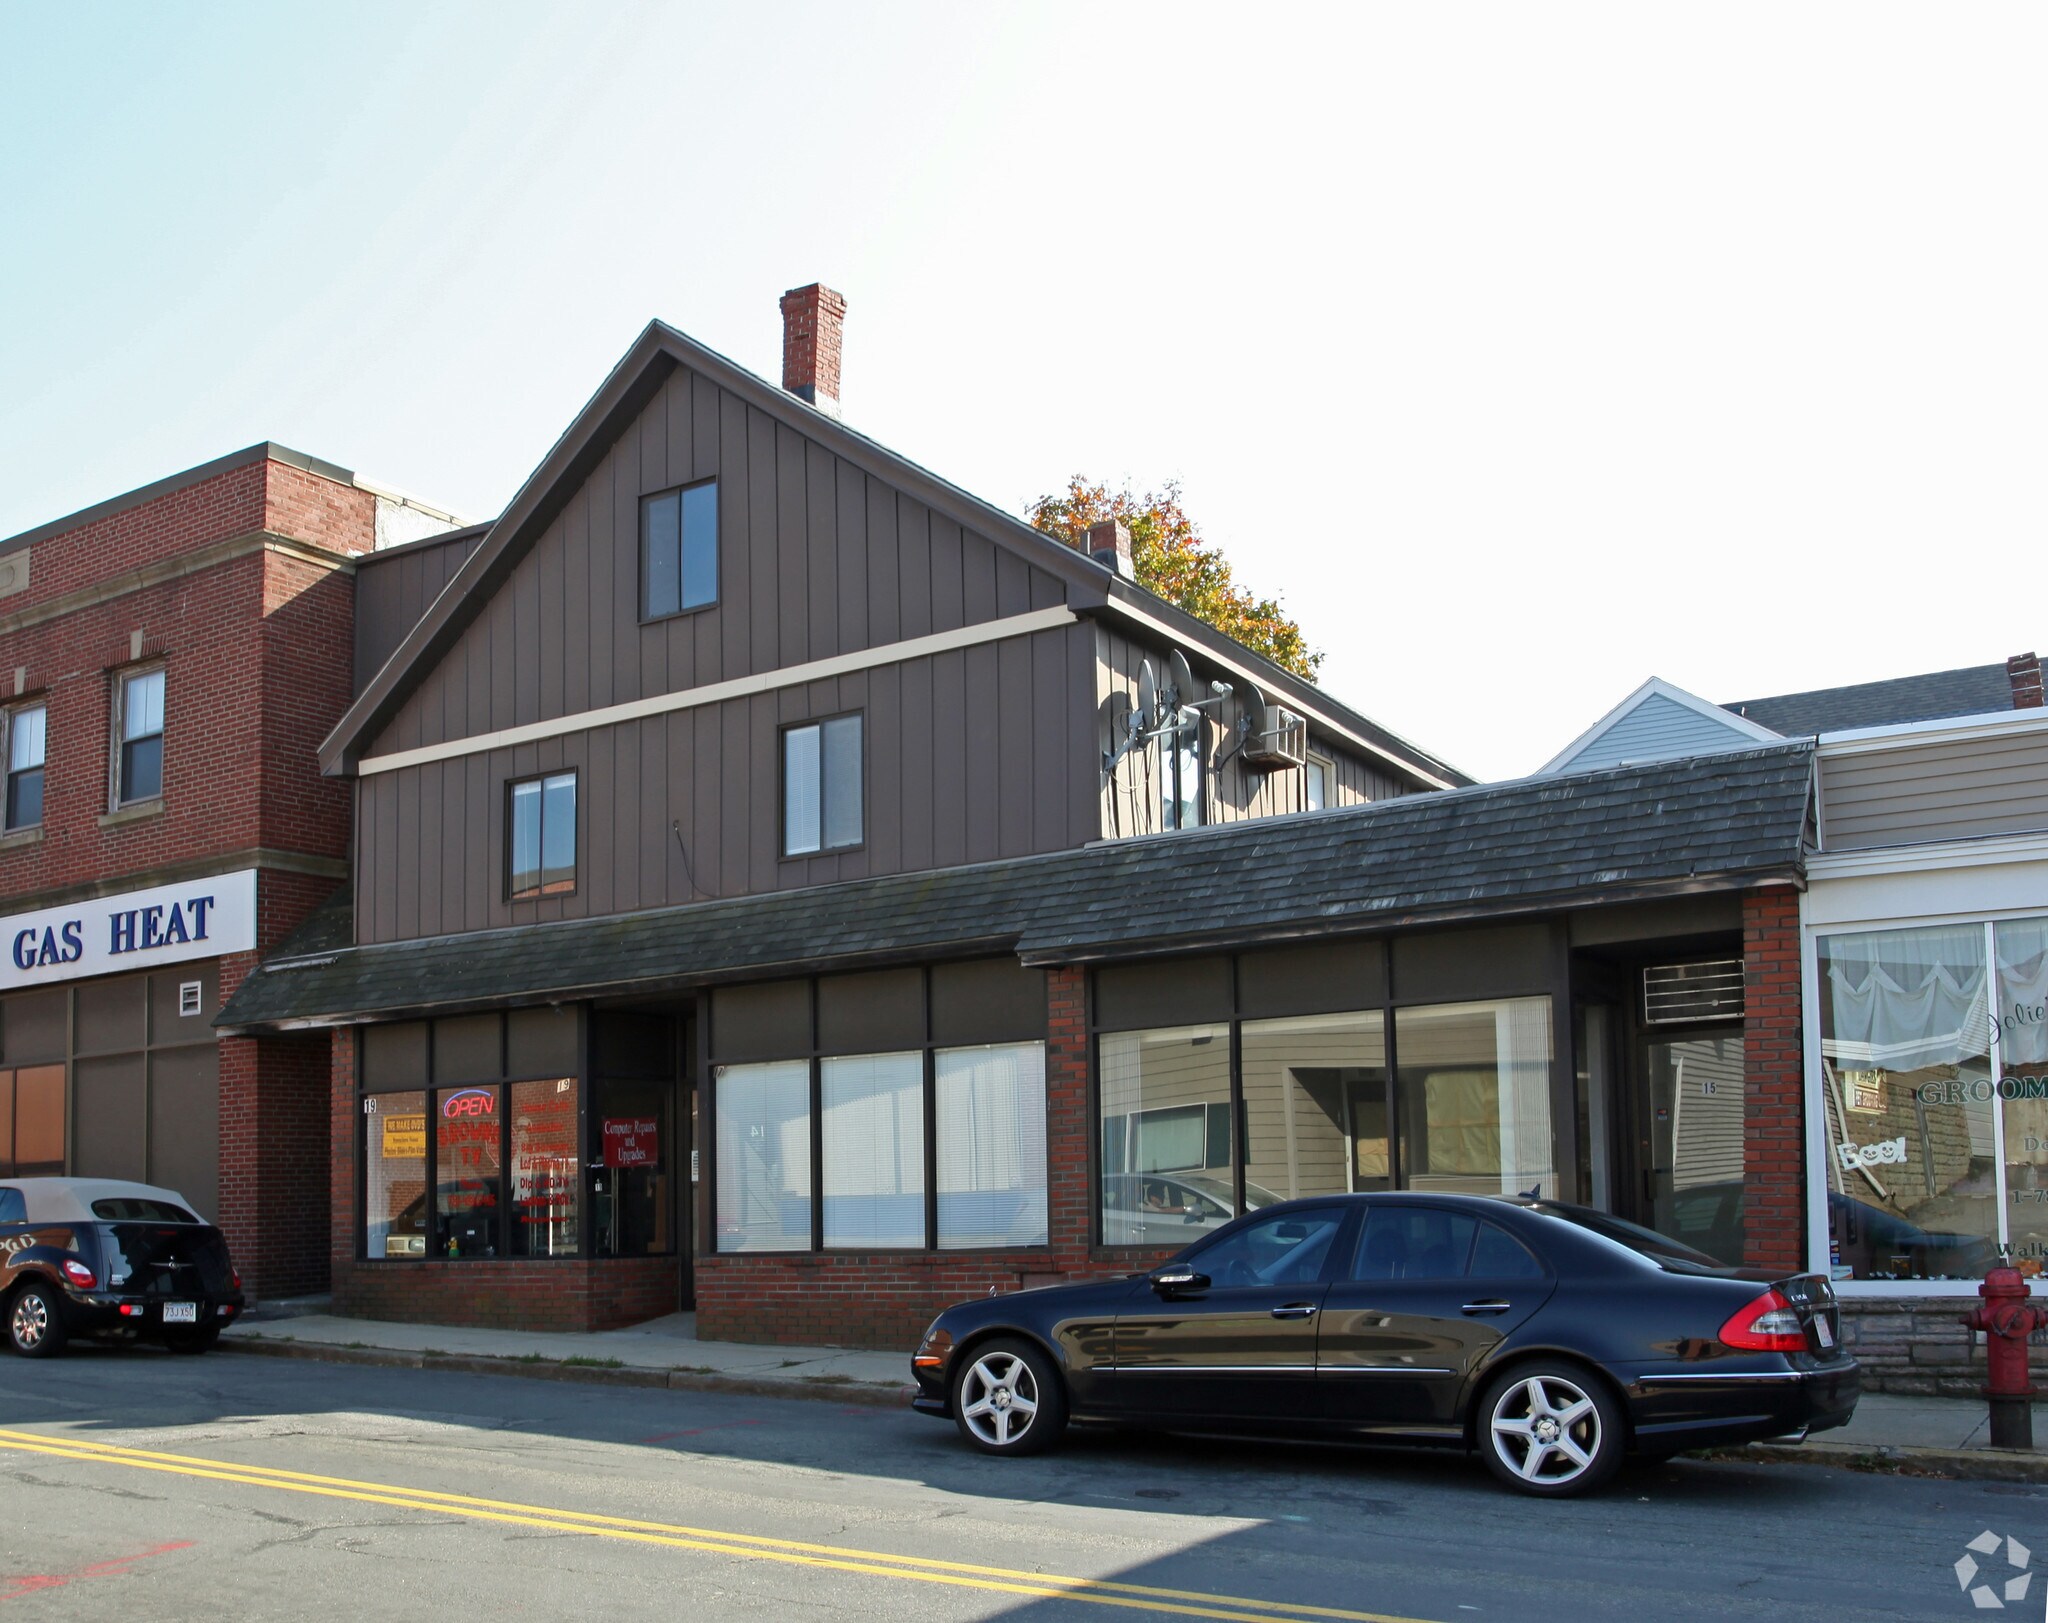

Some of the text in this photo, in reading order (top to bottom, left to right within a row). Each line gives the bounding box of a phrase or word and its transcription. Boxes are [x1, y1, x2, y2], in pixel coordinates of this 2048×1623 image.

[12, 895, 214, 970] GAS HEAT
[559, 1079, 570, 1092] 19
[1703, 1082, 1716, 1095] 15
[365, 1099, 376, 1113] 19
[446, 1096, 494, 1118] OPEN
[604, 1120, 656, 1136] Computer Repairs
[624, 1135, 635, 1147] and
[459, 1147, 481, 1167] TV
[618, 1147, 646, 1164] Upgrades
